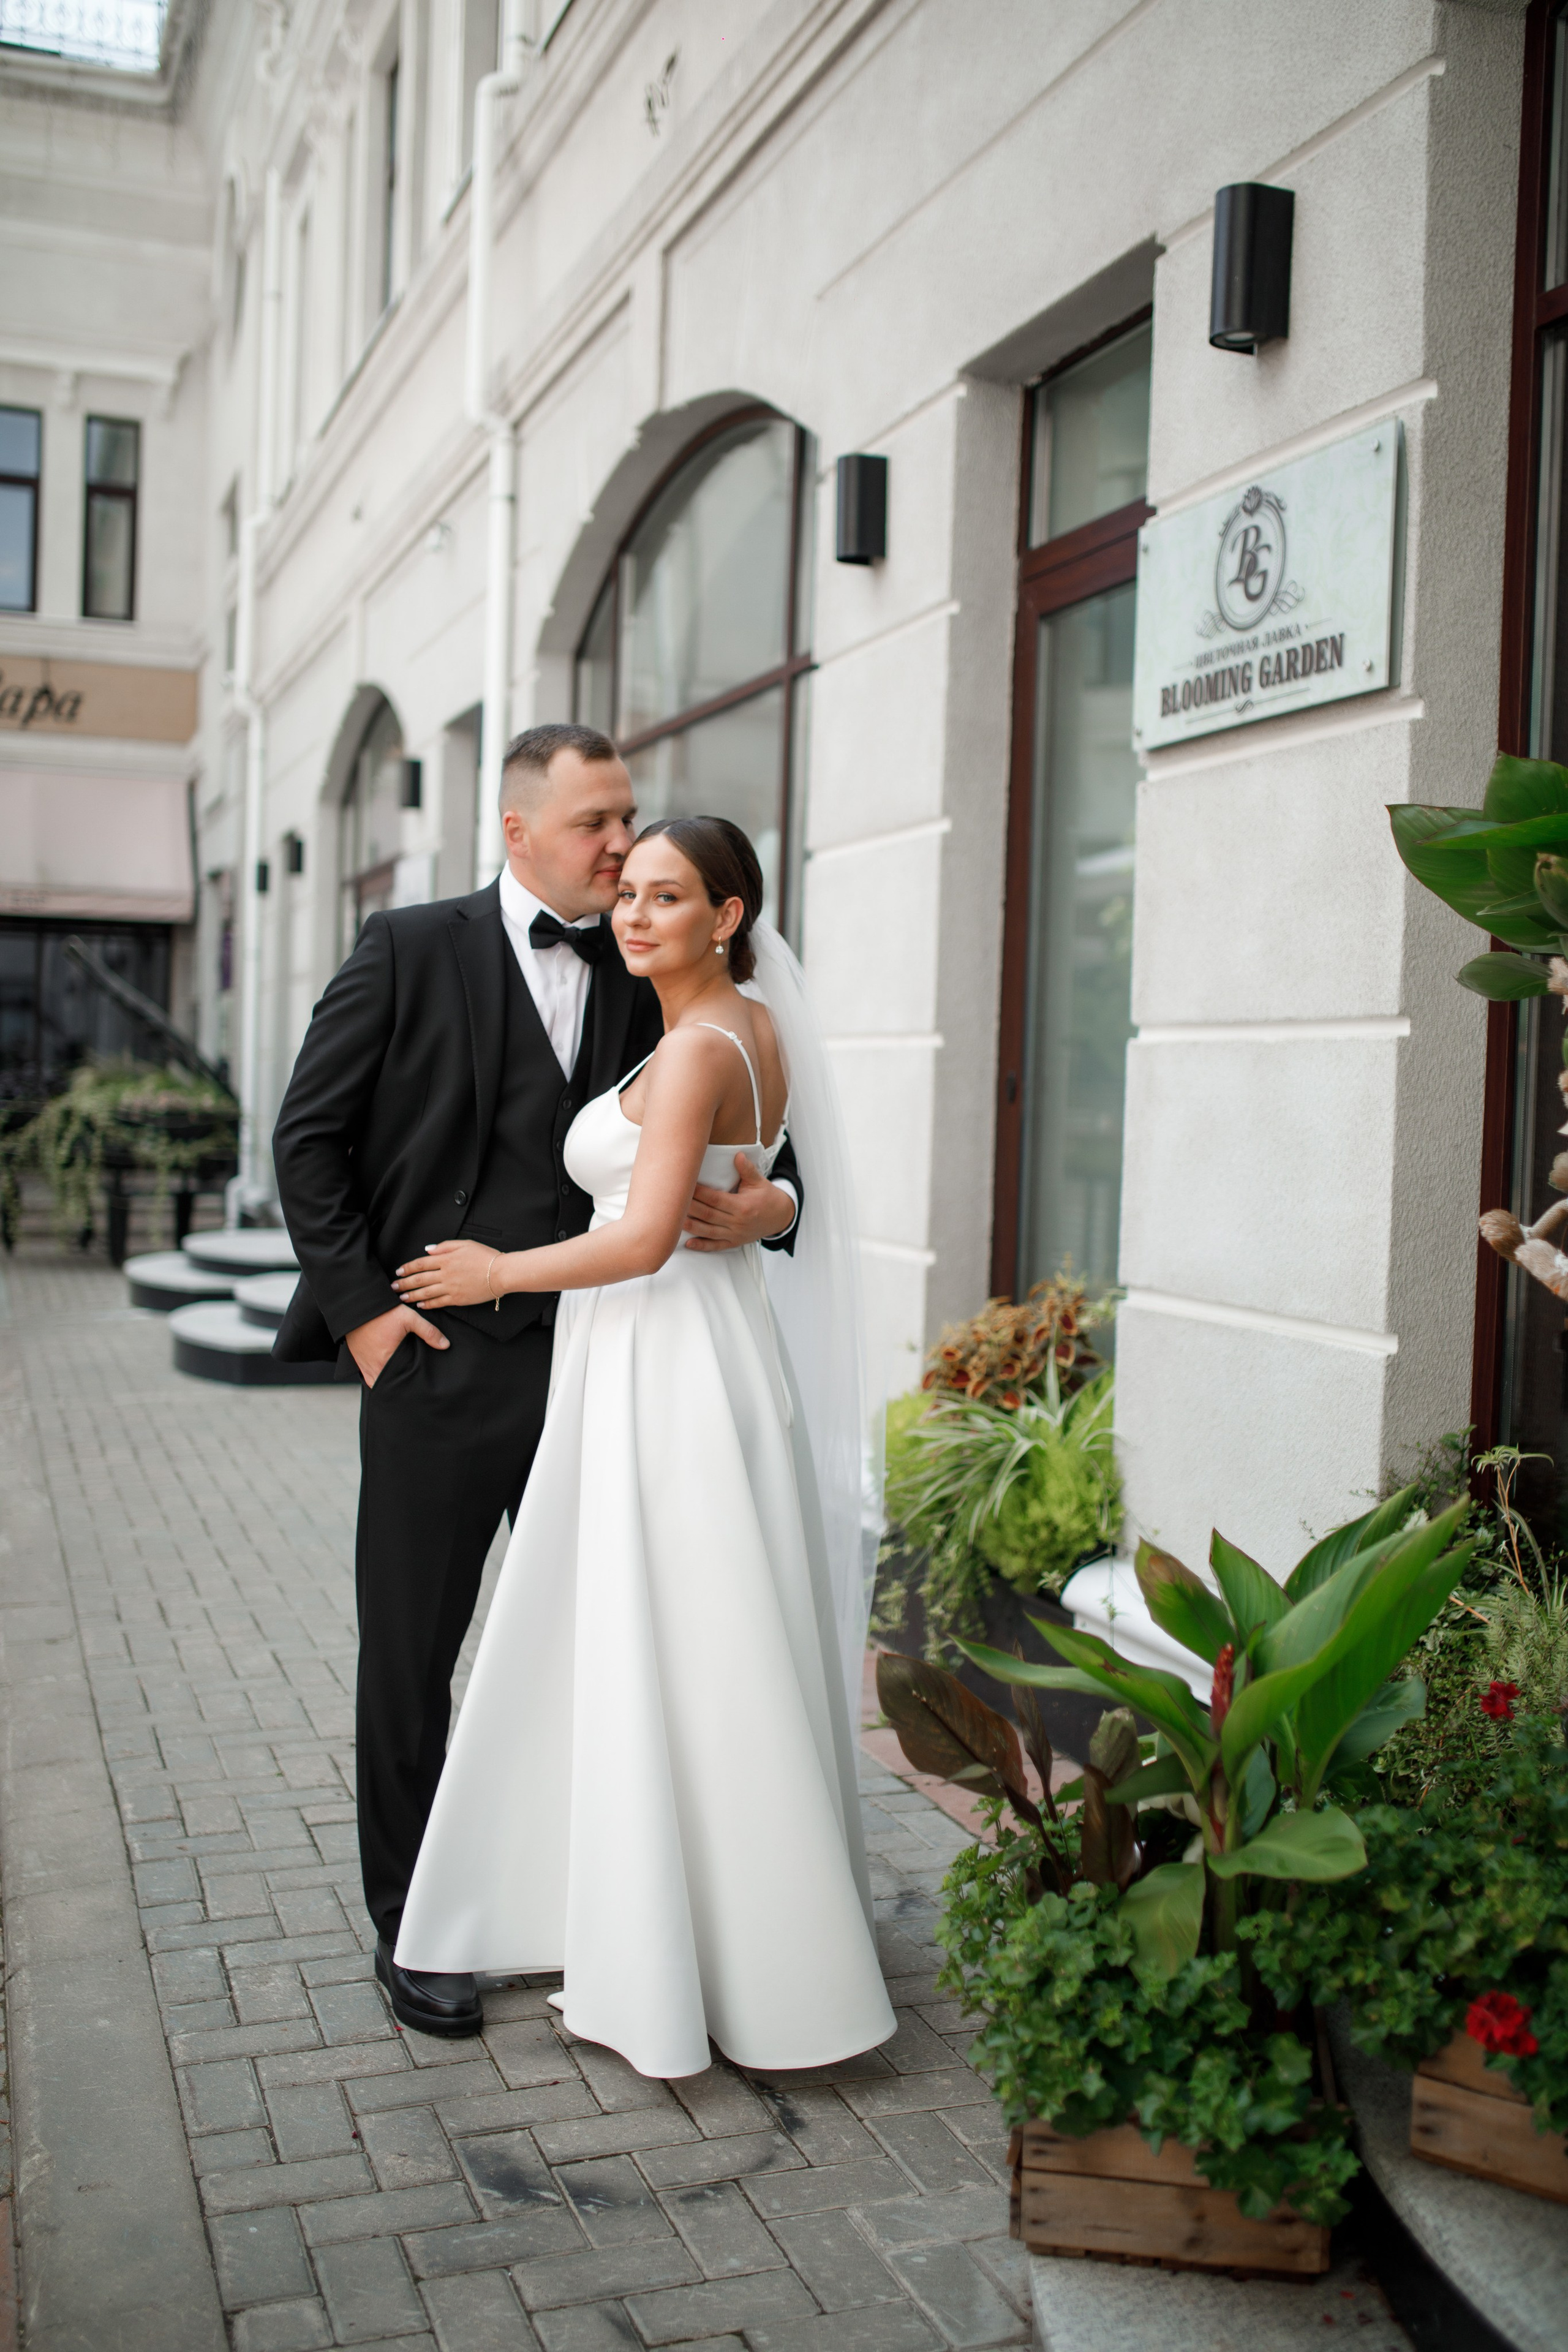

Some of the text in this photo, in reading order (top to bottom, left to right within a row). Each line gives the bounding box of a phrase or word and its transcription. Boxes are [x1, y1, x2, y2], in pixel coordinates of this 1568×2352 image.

[1161, 632, 1344, 718] BLOOMING GARDEN
[1196, 623, 1301, 668] ЦВЕТОЧНАЯ ЛАВКА
